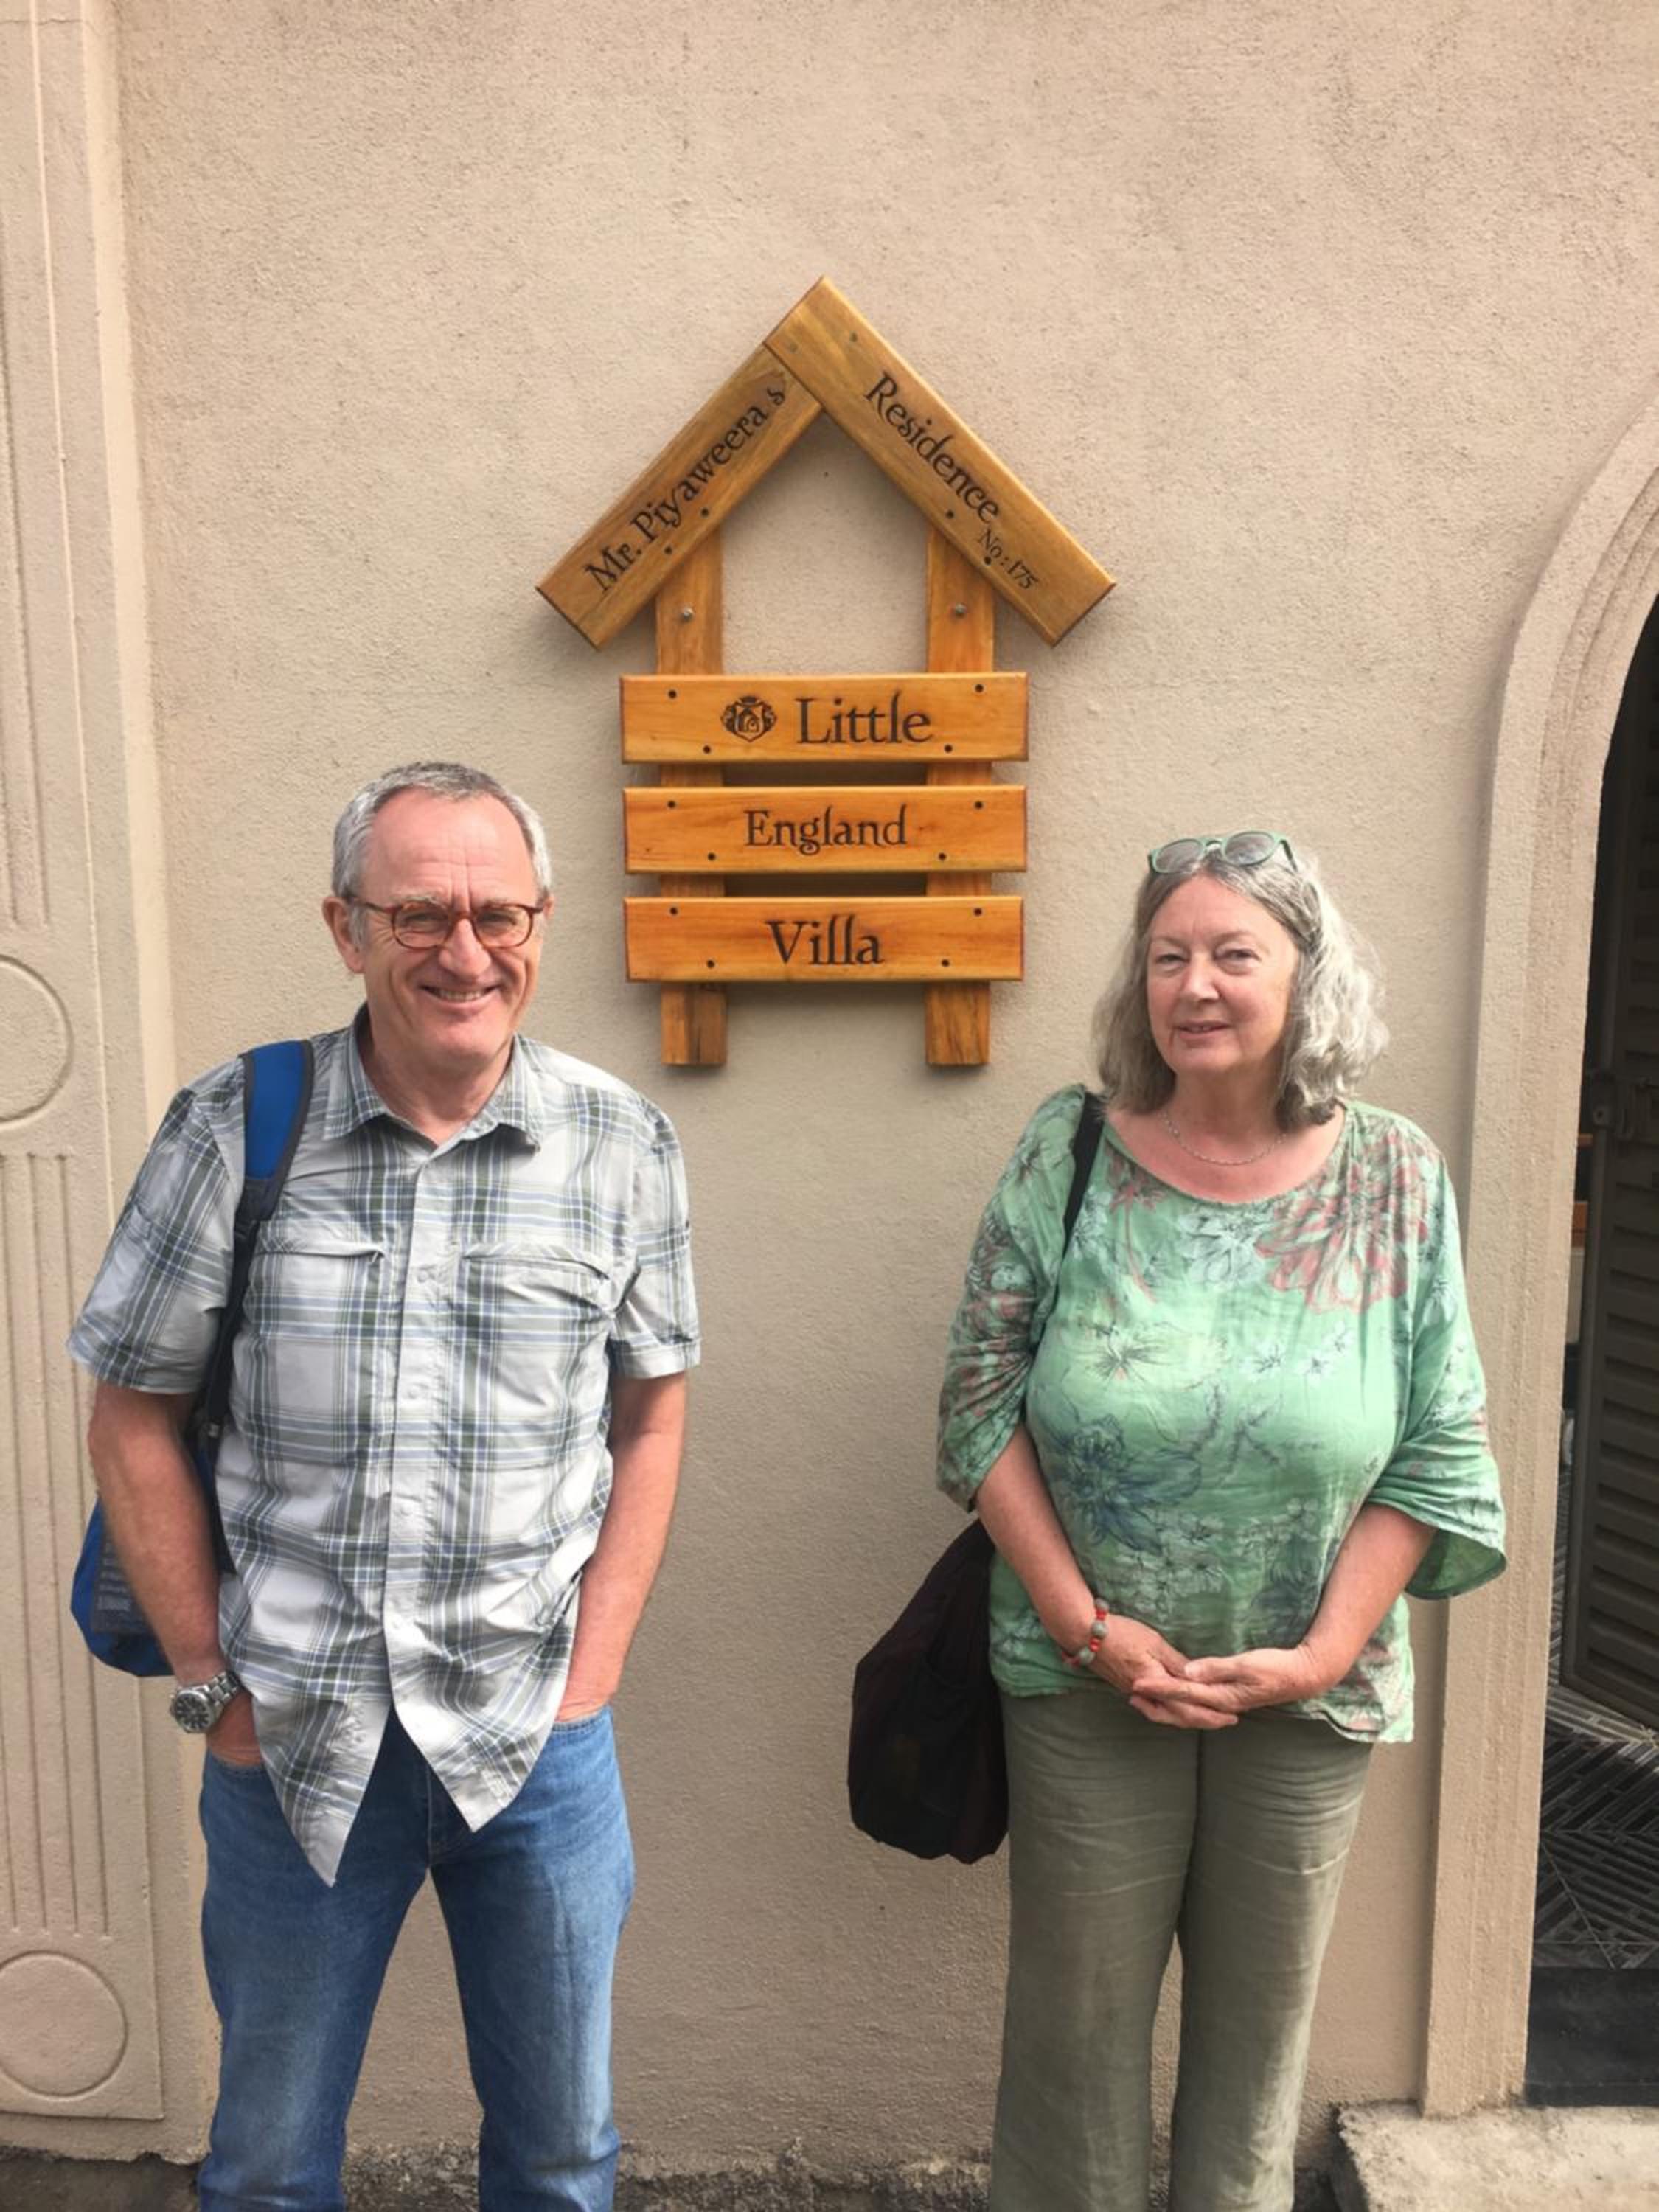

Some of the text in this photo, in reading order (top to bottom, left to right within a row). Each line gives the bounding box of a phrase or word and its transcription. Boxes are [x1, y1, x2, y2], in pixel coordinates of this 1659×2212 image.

[863, 371, 999, 524] Residence
[585, 543, 643, 592] Mr.
[796, 690, 933, 744] Little
[744, 804, 907, 855] England
[765, 914, 884, 967] Villa
